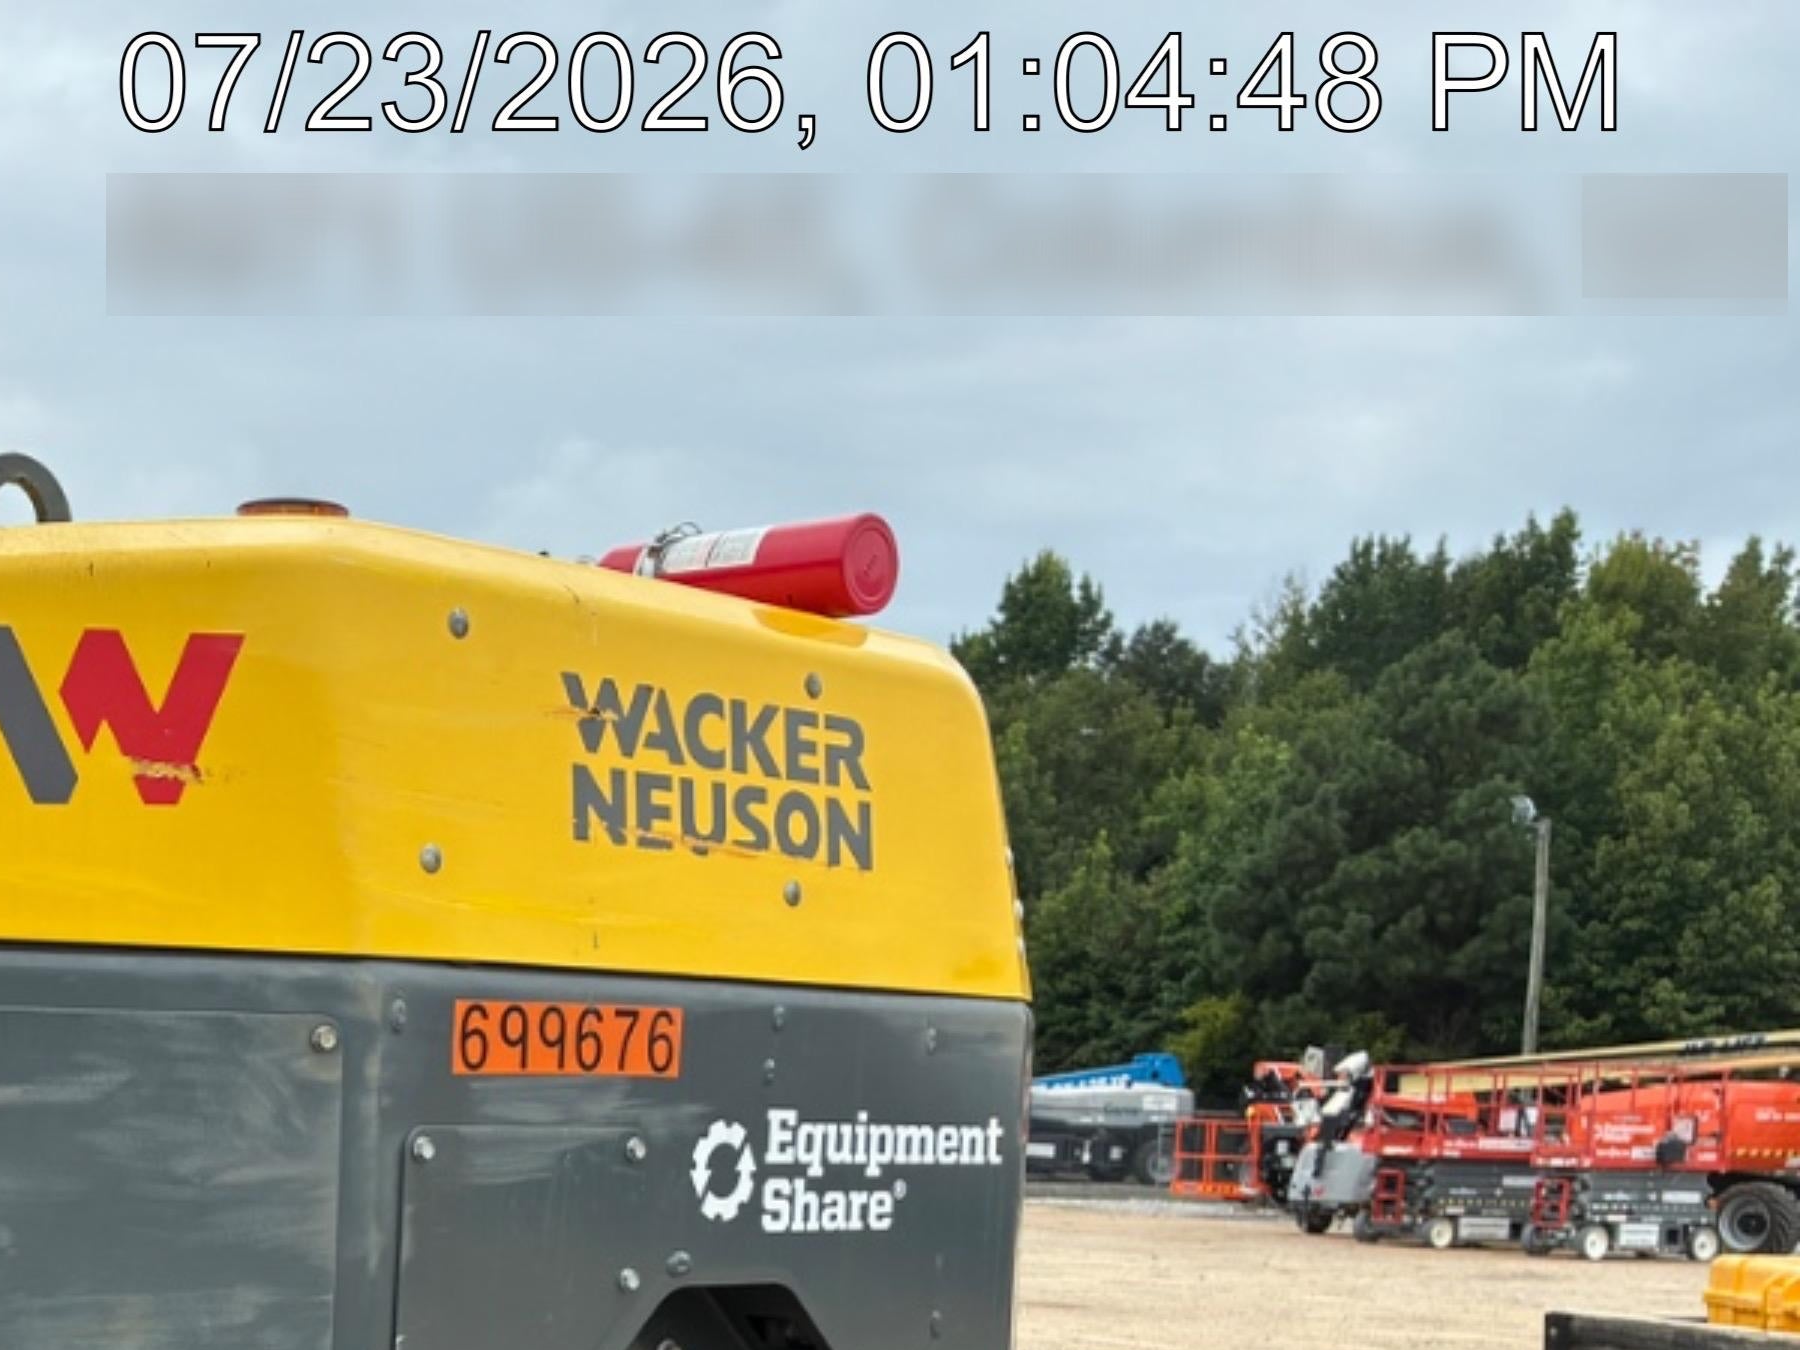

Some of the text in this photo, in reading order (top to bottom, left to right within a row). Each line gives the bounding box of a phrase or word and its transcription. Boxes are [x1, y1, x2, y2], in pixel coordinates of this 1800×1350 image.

[560, 671, 871, 791] WACKER
[572, 764, 874, 871] NEUSON
[459, 1003, 675, 1074] 699676
[764, 1108, 1005, 1177] Equipment
